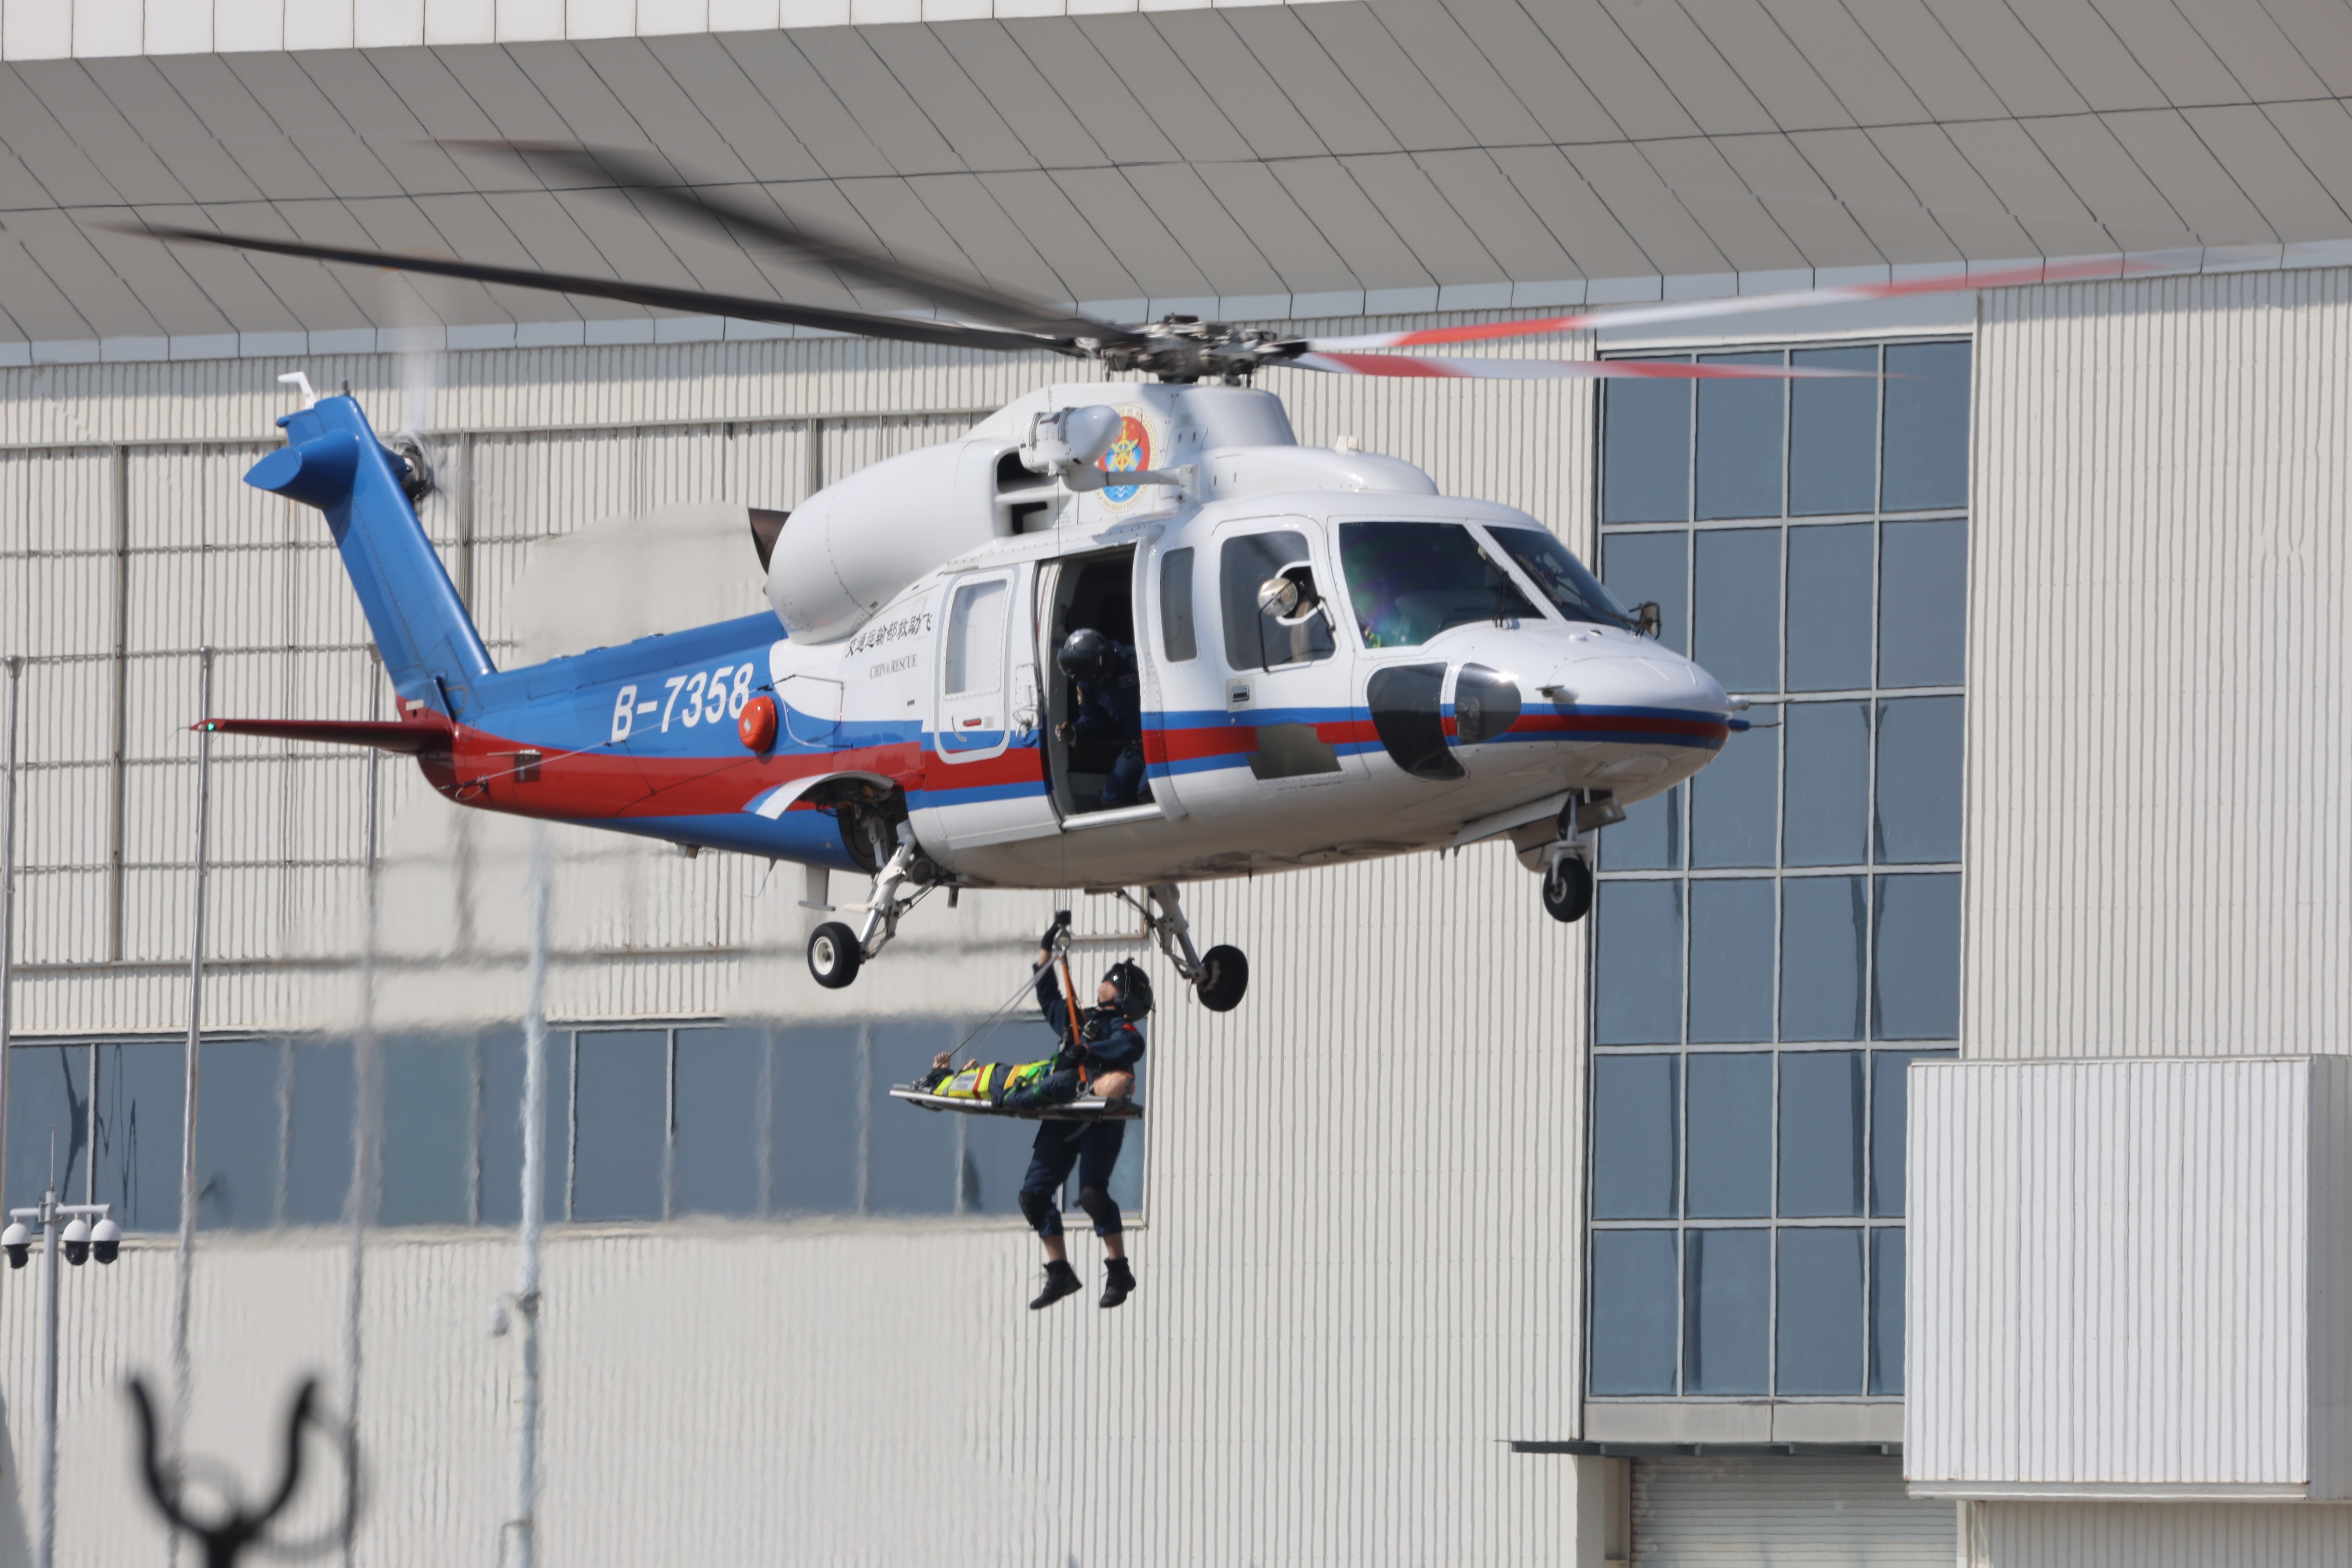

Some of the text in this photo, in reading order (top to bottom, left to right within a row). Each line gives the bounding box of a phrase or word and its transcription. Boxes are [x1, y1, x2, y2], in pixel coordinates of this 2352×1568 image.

[870, 653, 917, 679] CHINA RESCUE
[612, 662, 754, 742] B-7358
